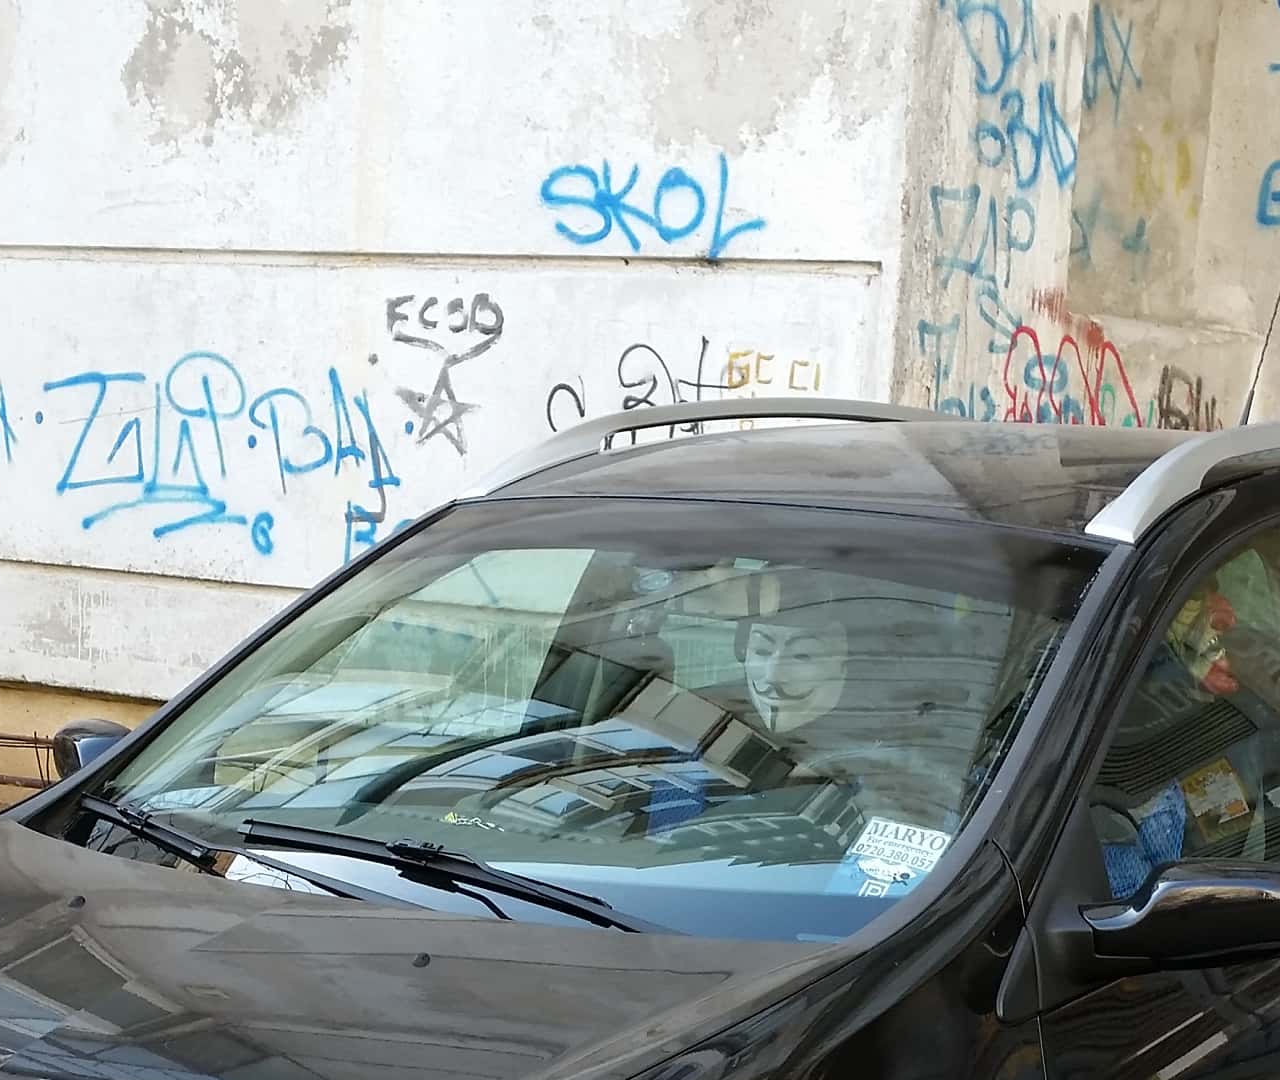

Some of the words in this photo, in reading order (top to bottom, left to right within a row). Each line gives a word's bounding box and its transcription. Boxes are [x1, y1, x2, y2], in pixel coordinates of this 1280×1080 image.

[539, 152, 766, 259] SKOL
[868, 822, 946, 851] MARYO
[856, 843, 934, 869] 0720.380.057
